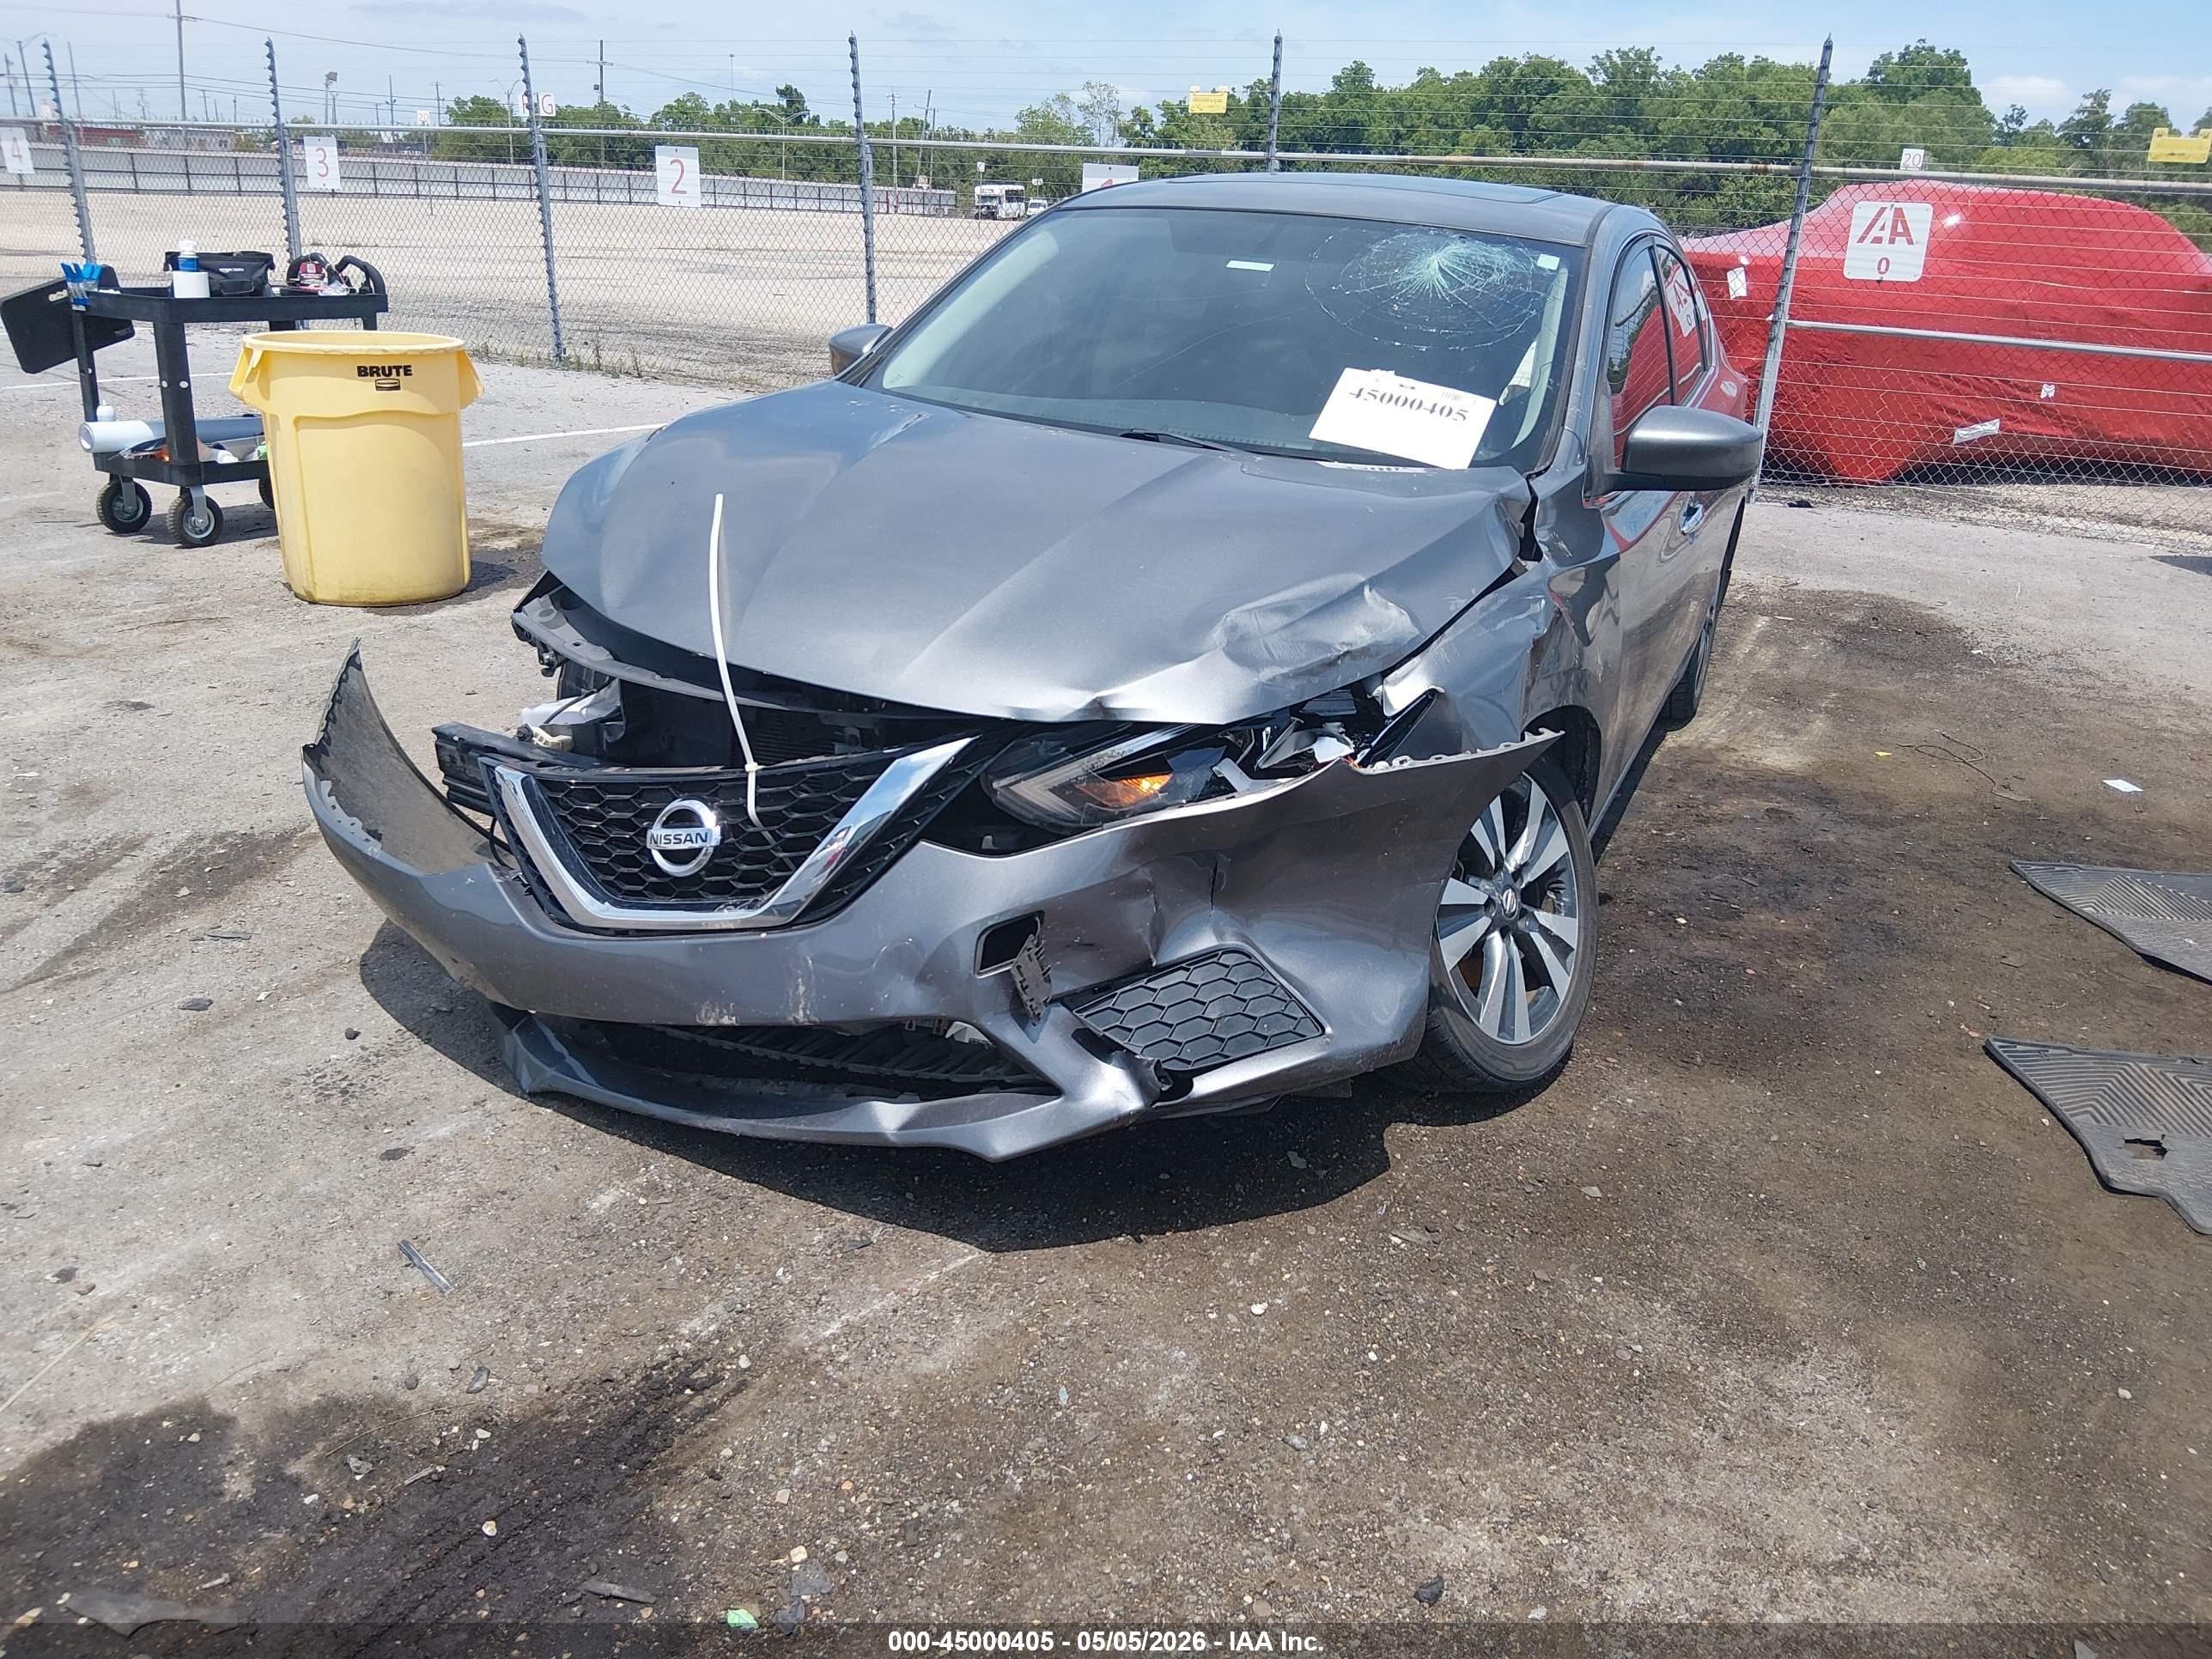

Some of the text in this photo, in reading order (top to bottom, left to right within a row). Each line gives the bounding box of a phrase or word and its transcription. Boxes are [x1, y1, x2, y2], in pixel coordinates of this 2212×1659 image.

[541, 94, 554, 115] G
[11, 137, 23, 164] 4
[1902, 153, 1922, 167] 20
[315, 147, 329, 178] 3
[670, 158, 688, 195] 2
[1876, 257, 1891, 275] 0
[356, 365, 413, 378] BRUTE
[1349, 386, 1469, 422] 45000405
[649, 831, 708, 846] NISSAN
